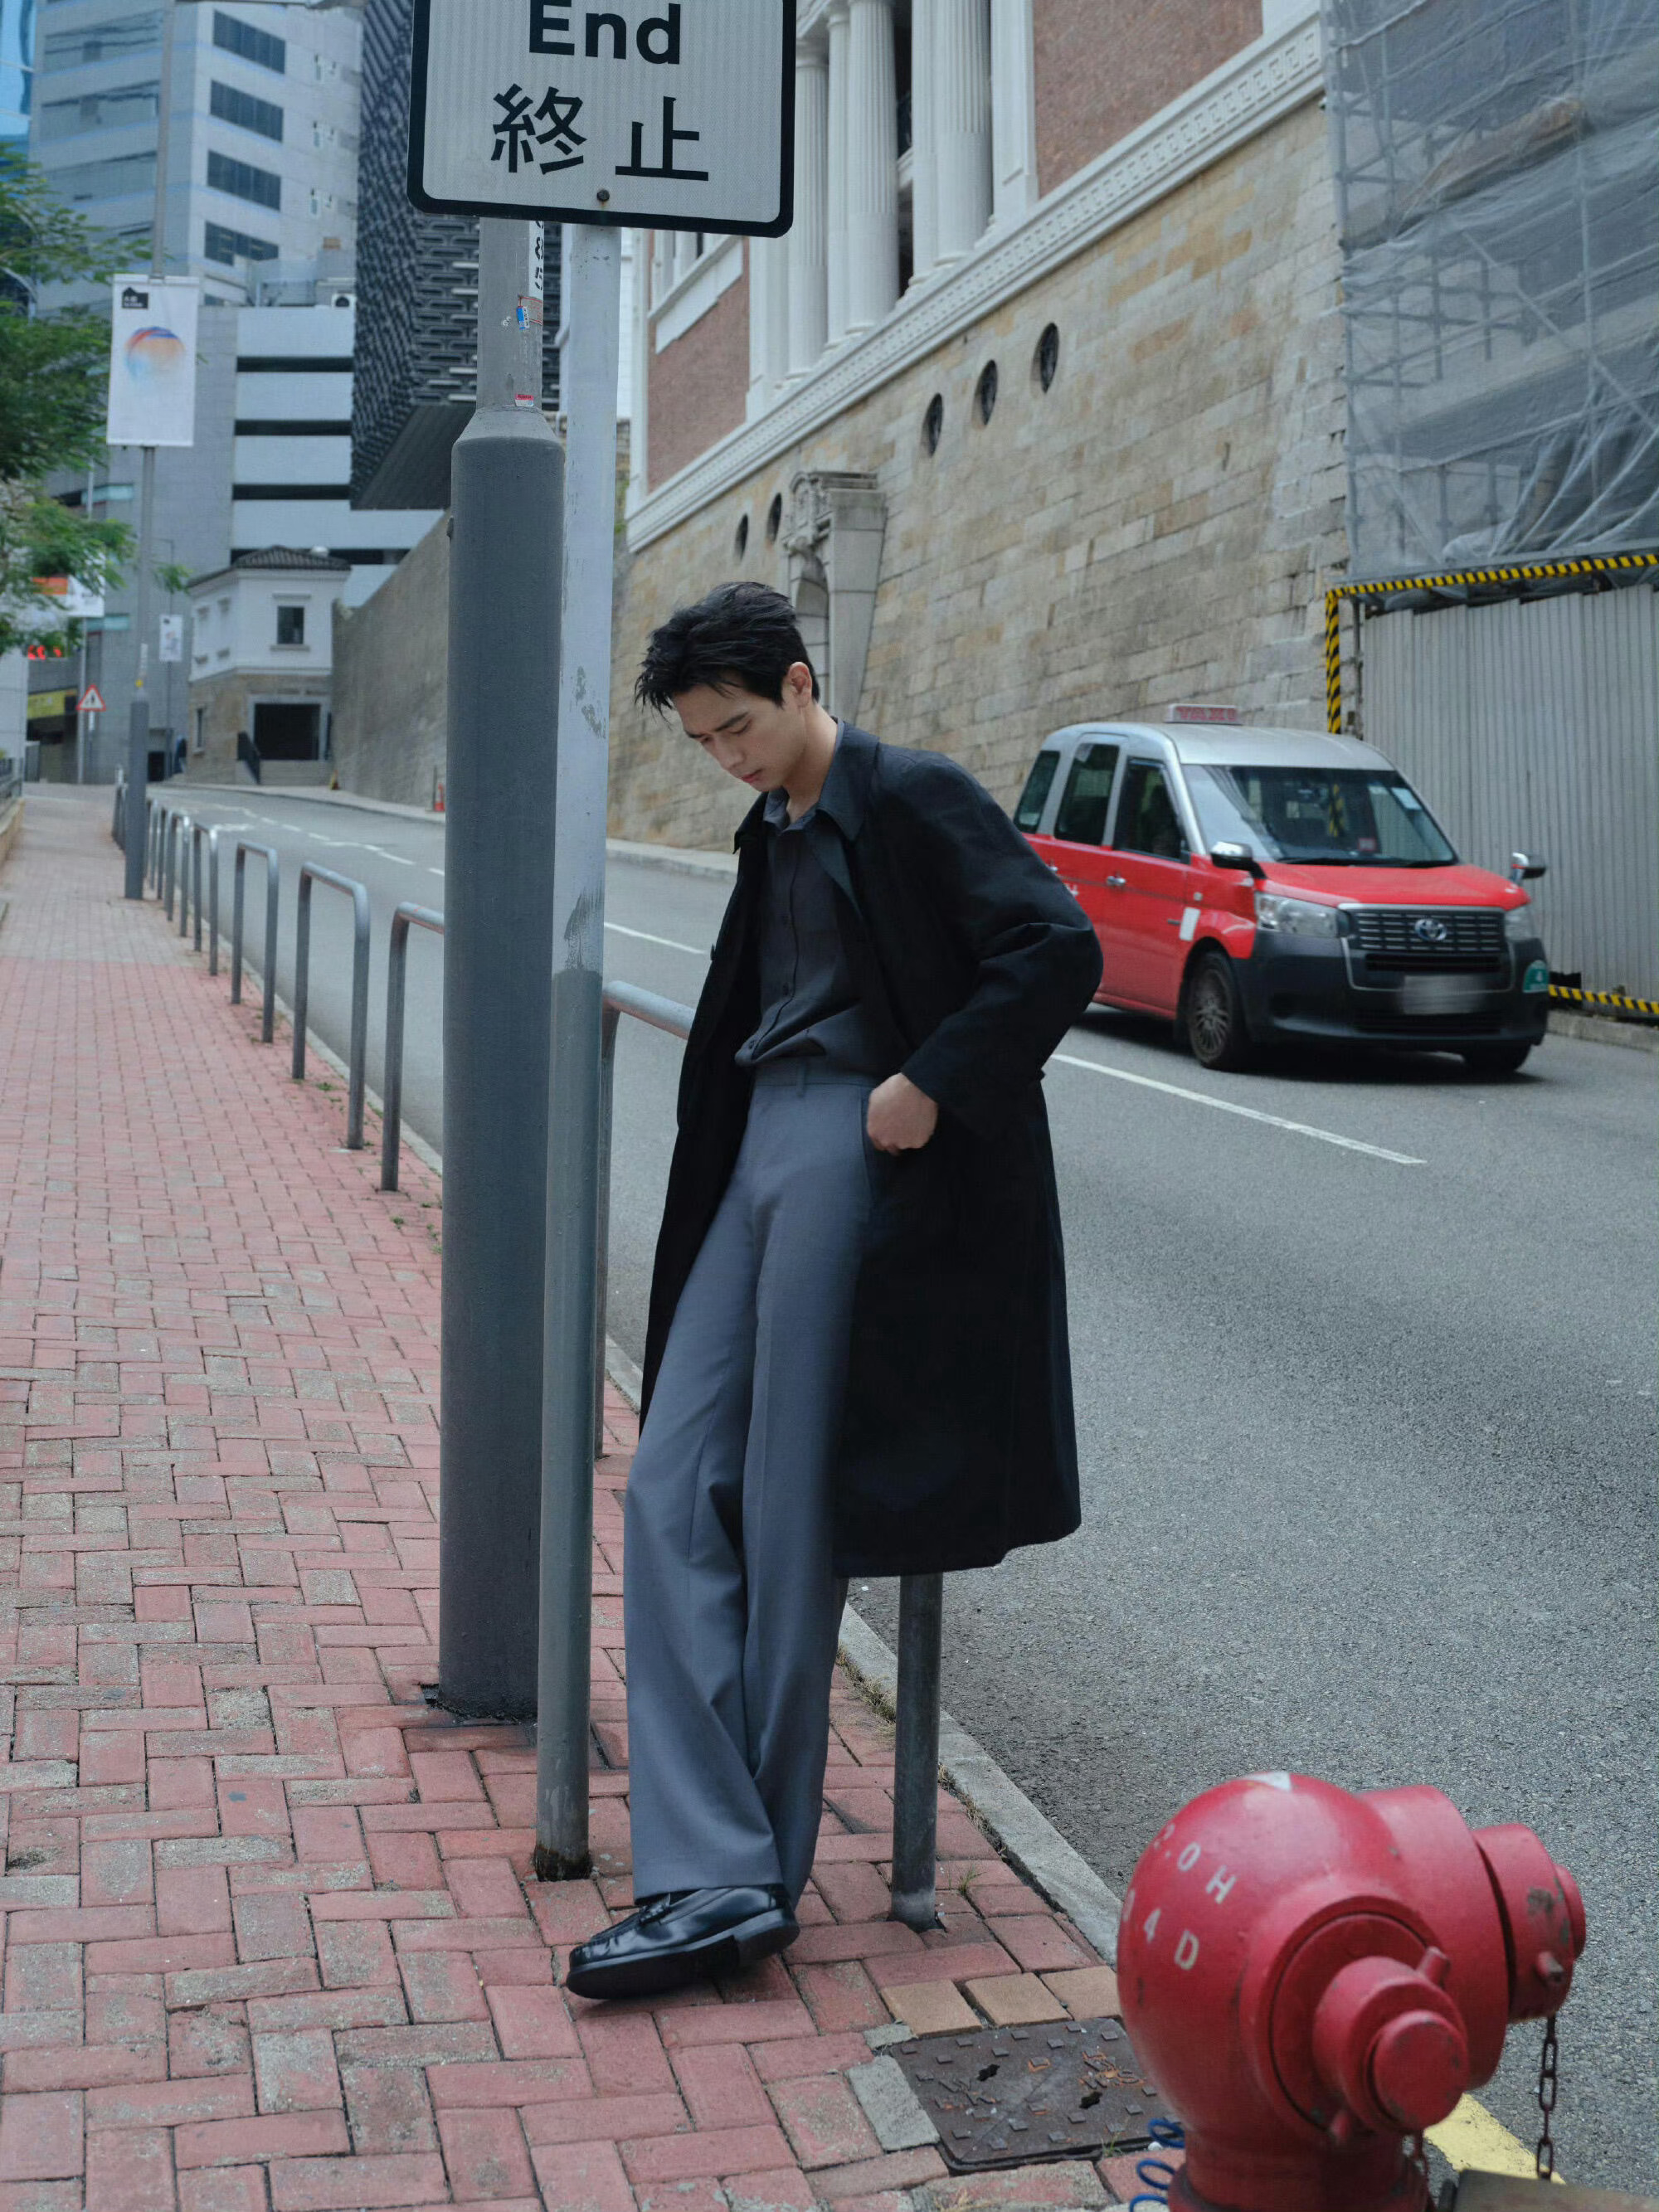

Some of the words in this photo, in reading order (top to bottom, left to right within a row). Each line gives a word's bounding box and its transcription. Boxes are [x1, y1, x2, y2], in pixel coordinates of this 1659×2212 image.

[528, 0, 681, 65] End
[490, 84, 709, 182] 終止
[1175, 706, 1238, 722] TAXI
